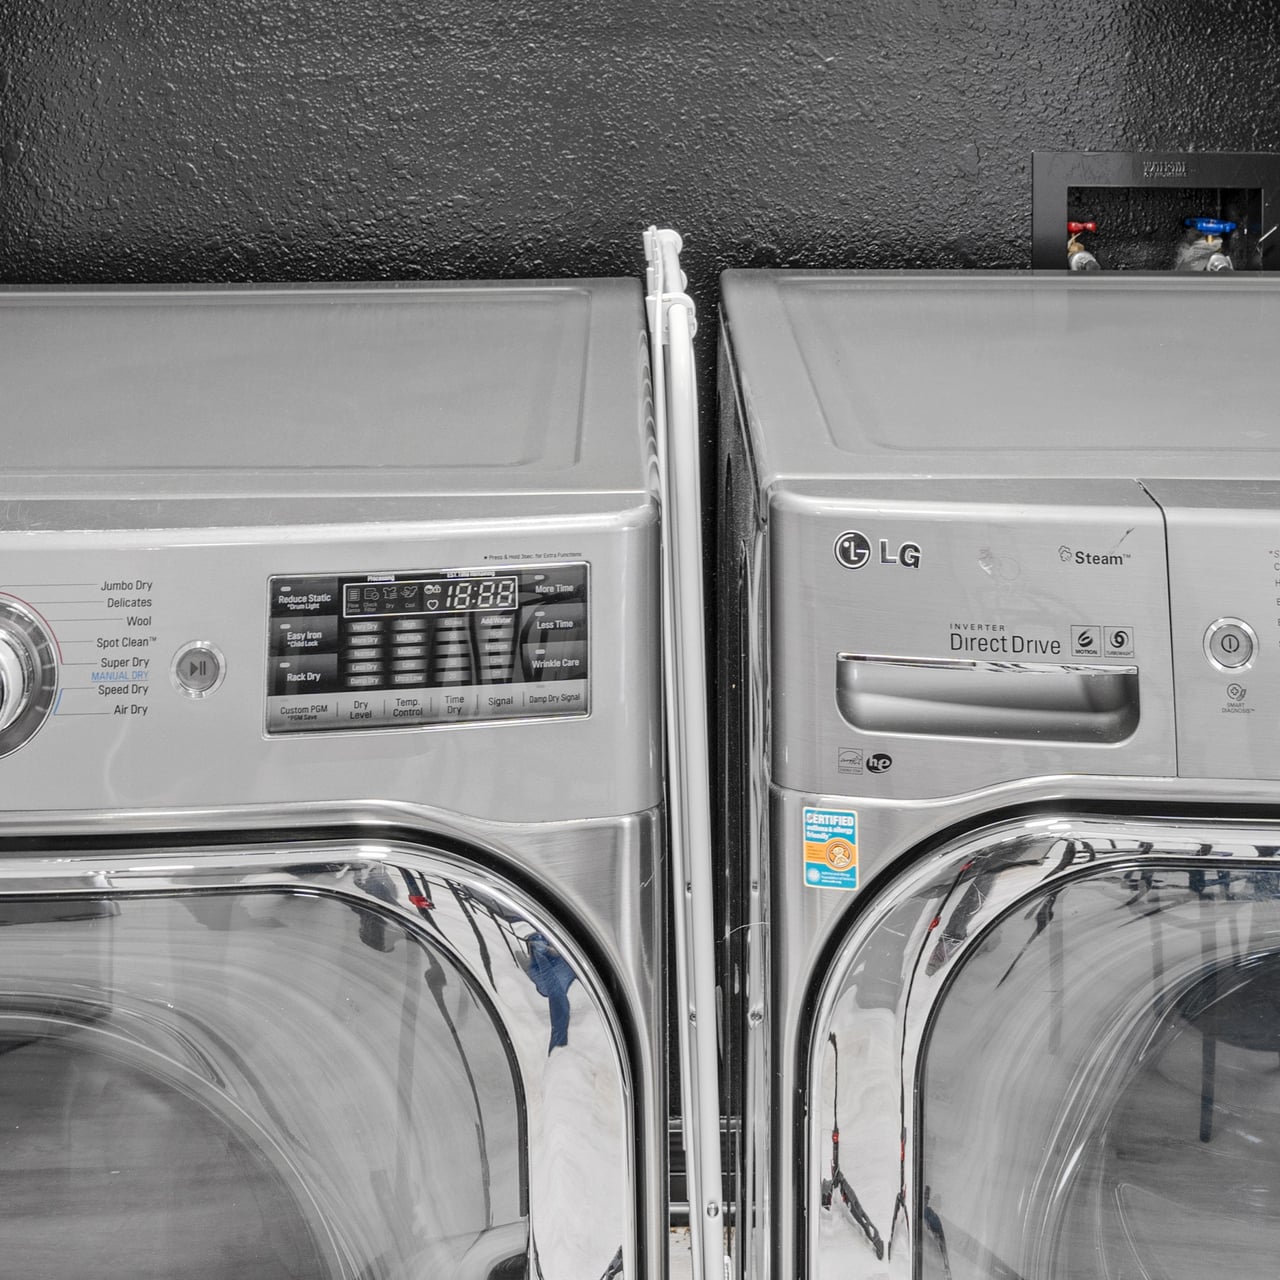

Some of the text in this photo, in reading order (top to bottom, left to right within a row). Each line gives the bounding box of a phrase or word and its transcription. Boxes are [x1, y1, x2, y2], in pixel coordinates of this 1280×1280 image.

[879, 538, 922, 569] LG
[101, 580, 152, 592] Jumbo Dry
[536, 585, 554, 593] More
[107, 597, 152, 608] Delicates
[279, 594, 331, 603] Reduce Static
[127, 616, 152, 626] Wool
[537, 621, 554, 629] Less
[950, 623, 1005, 631] INVERTER
[287, 631, 322, 640] Easy Iron
[96, 638, 119, 649] Spot
[950, 633, 1061, 655] Direct Drive
[101, 657, 150, 669] Super Dry
[532, 660, 561, 668] Wrinkle
[91, 671, 148, 681] MANUAL DRY
[287, 673, 321, 681] Rack Dry
[98, 684, 149, 696] Speed Dry
[445, 695, 464, 704] Time
[488, 696, 513, 707] Signal
[529, 693, 581, 704] Damp Dry Signal
[114, 704, 148, 716] Air Dry
[281, 705, 328, 715] Custom PGM
[353, 701, 368, 710] Dry
[350, 710, 372, 720] Level
[393, 708, 423, 717] Control
[447, 706, 462, 716] Dry
[807, 813, 854, 826] CERTIFIED
